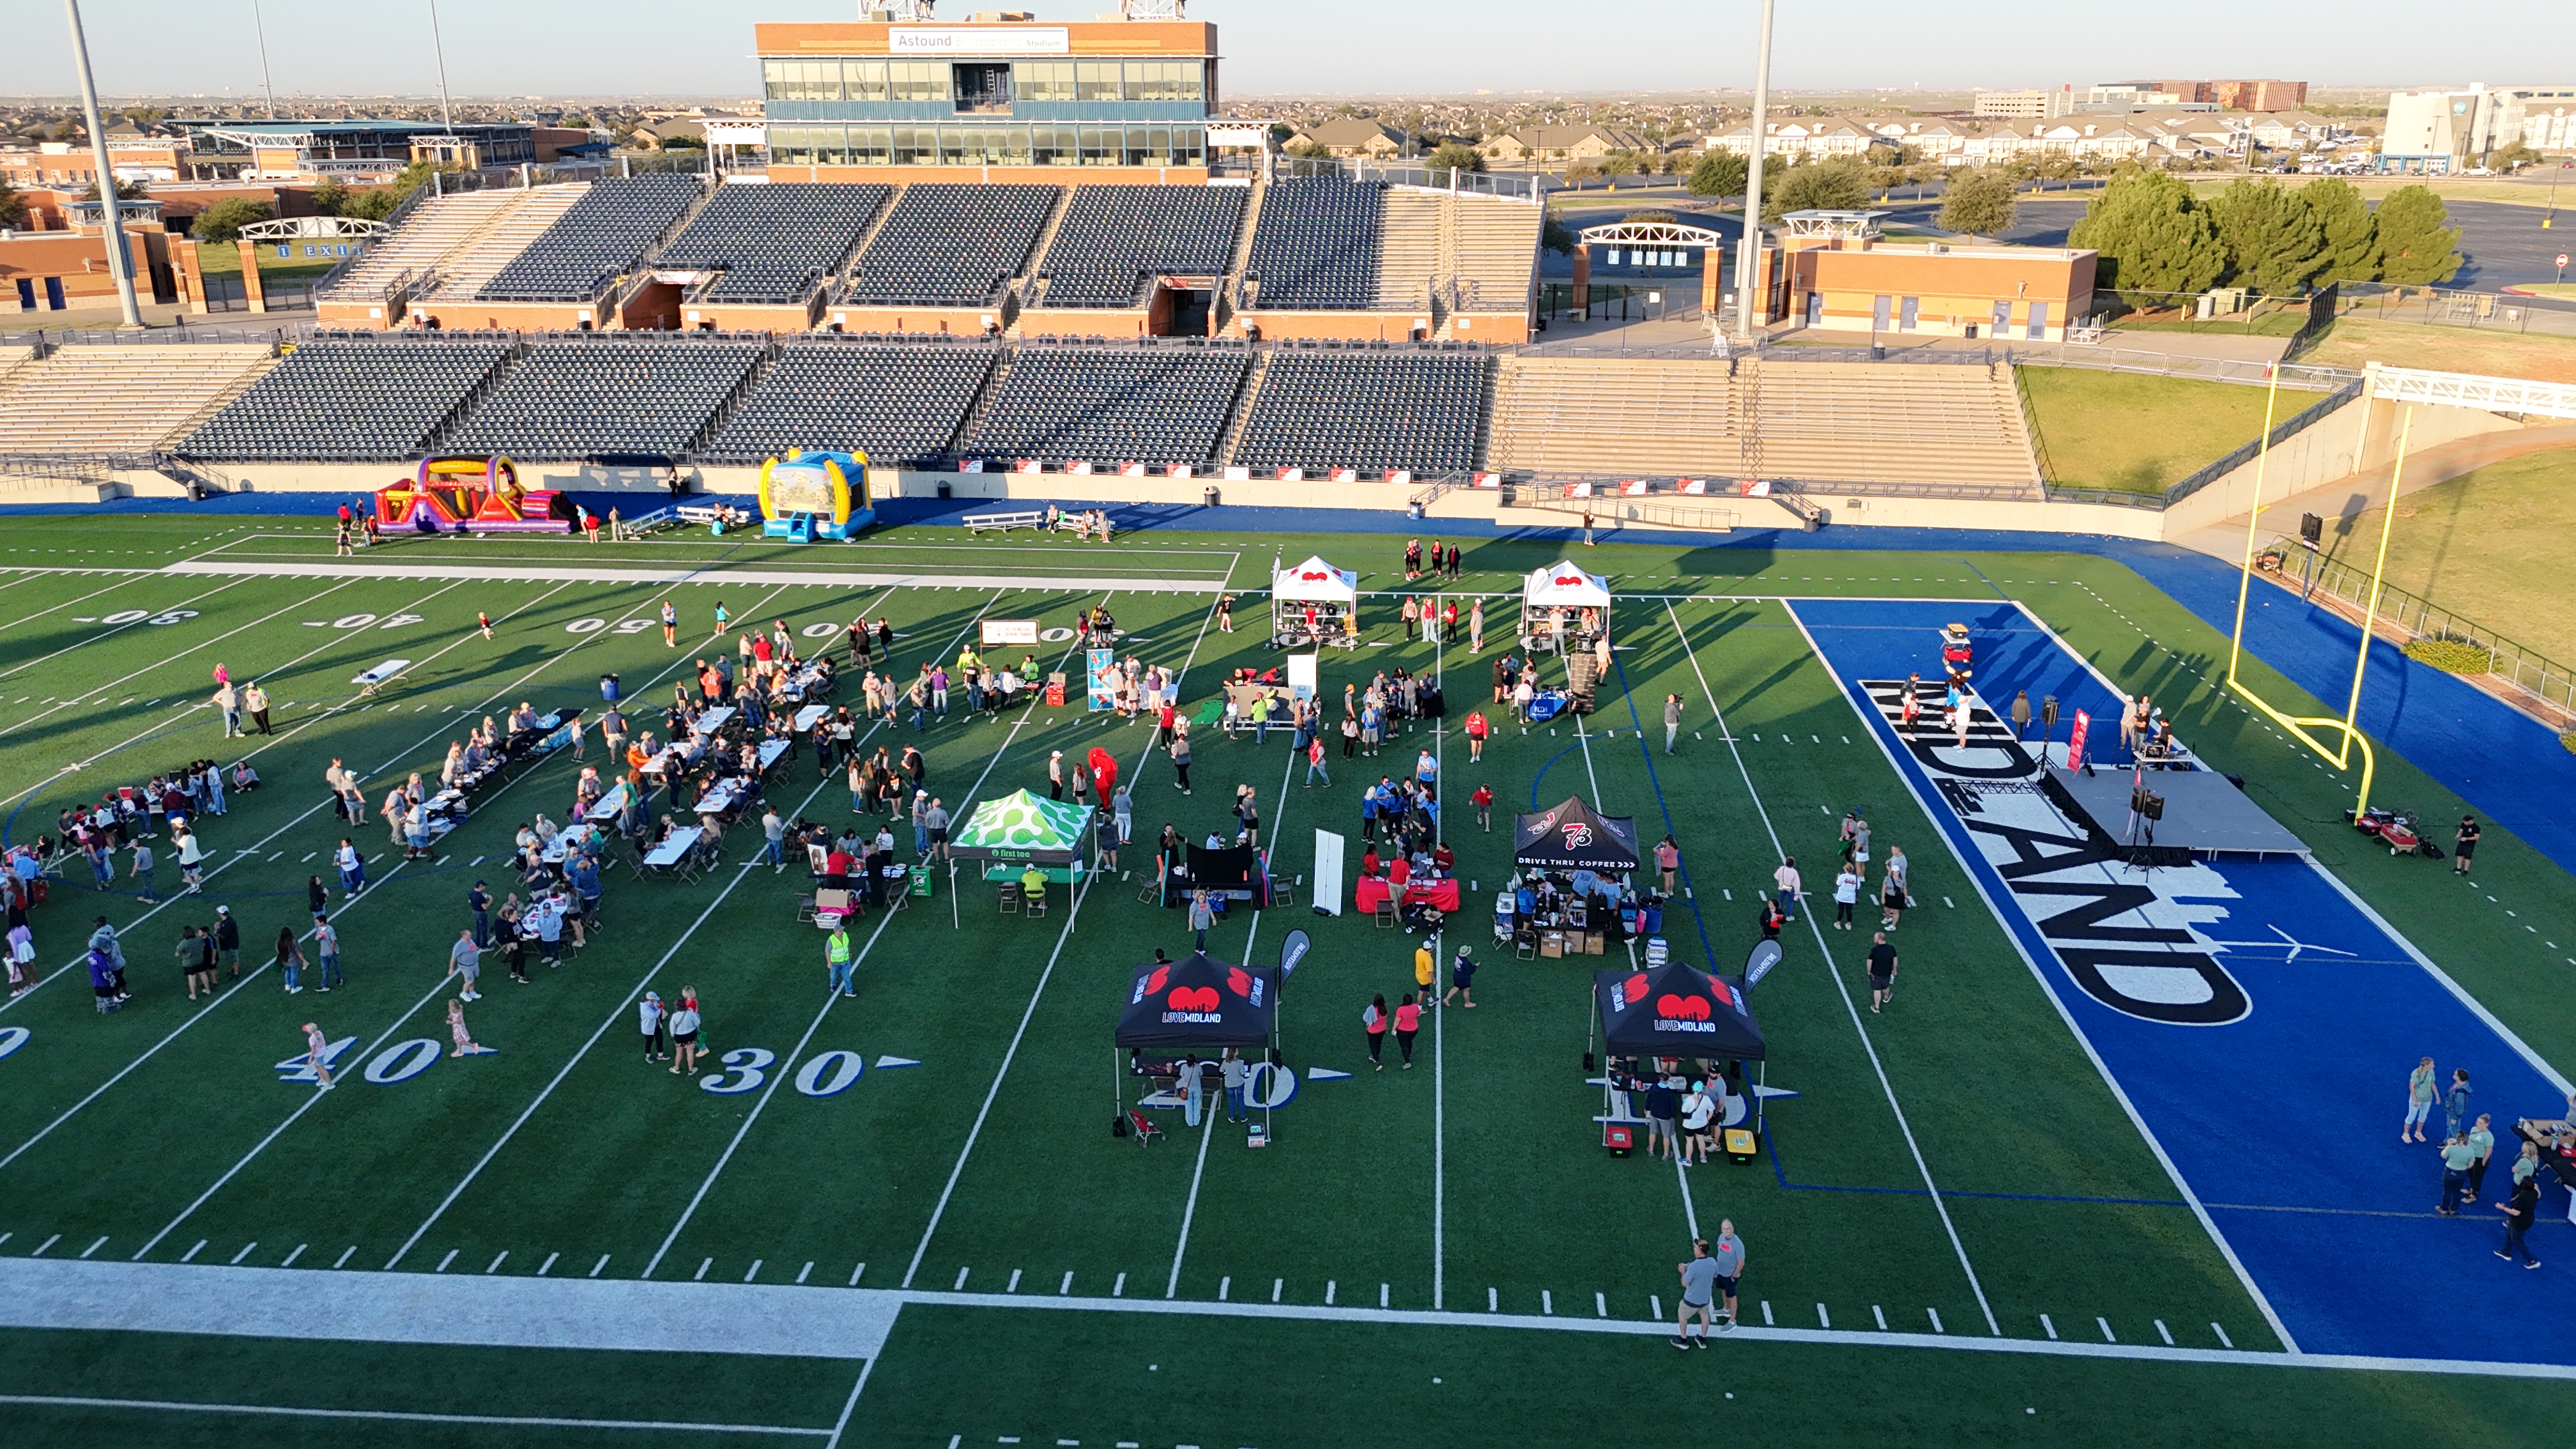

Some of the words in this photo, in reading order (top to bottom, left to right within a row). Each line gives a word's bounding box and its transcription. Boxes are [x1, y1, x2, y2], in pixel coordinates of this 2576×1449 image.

[898, 35, 952, 47] Astound
[956, 36, 1022, 47] Broadband
[1633, 253, 1685, 264] EXIT
[1162, 1011, 1222, 1023] LOVEMIDLAND
[1654, 1020, 1716, 1032] LOVEMIDLAND
